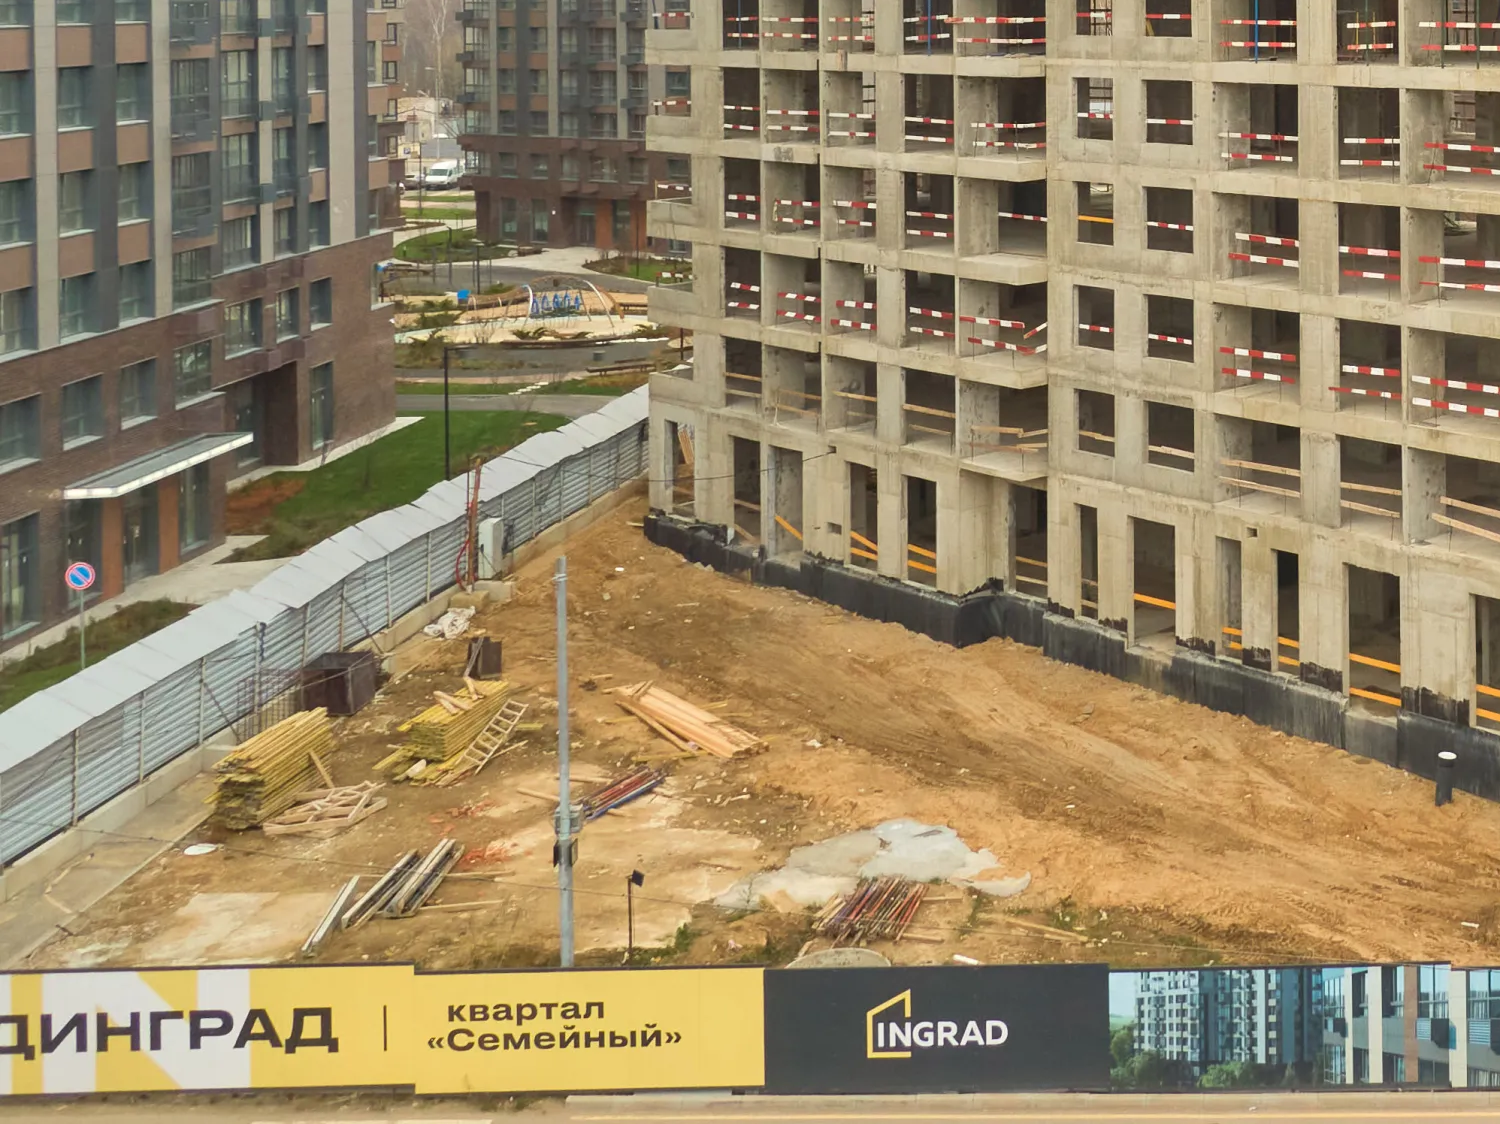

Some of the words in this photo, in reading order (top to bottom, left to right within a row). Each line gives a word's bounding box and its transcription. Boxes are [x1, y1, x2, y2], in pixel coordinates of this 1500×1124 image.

[447, 1001, 605, 1026] квартал
[427, 1023, 682, 1051] «Семейный»
[877, 1019, 1009, 1047] INGRAD
